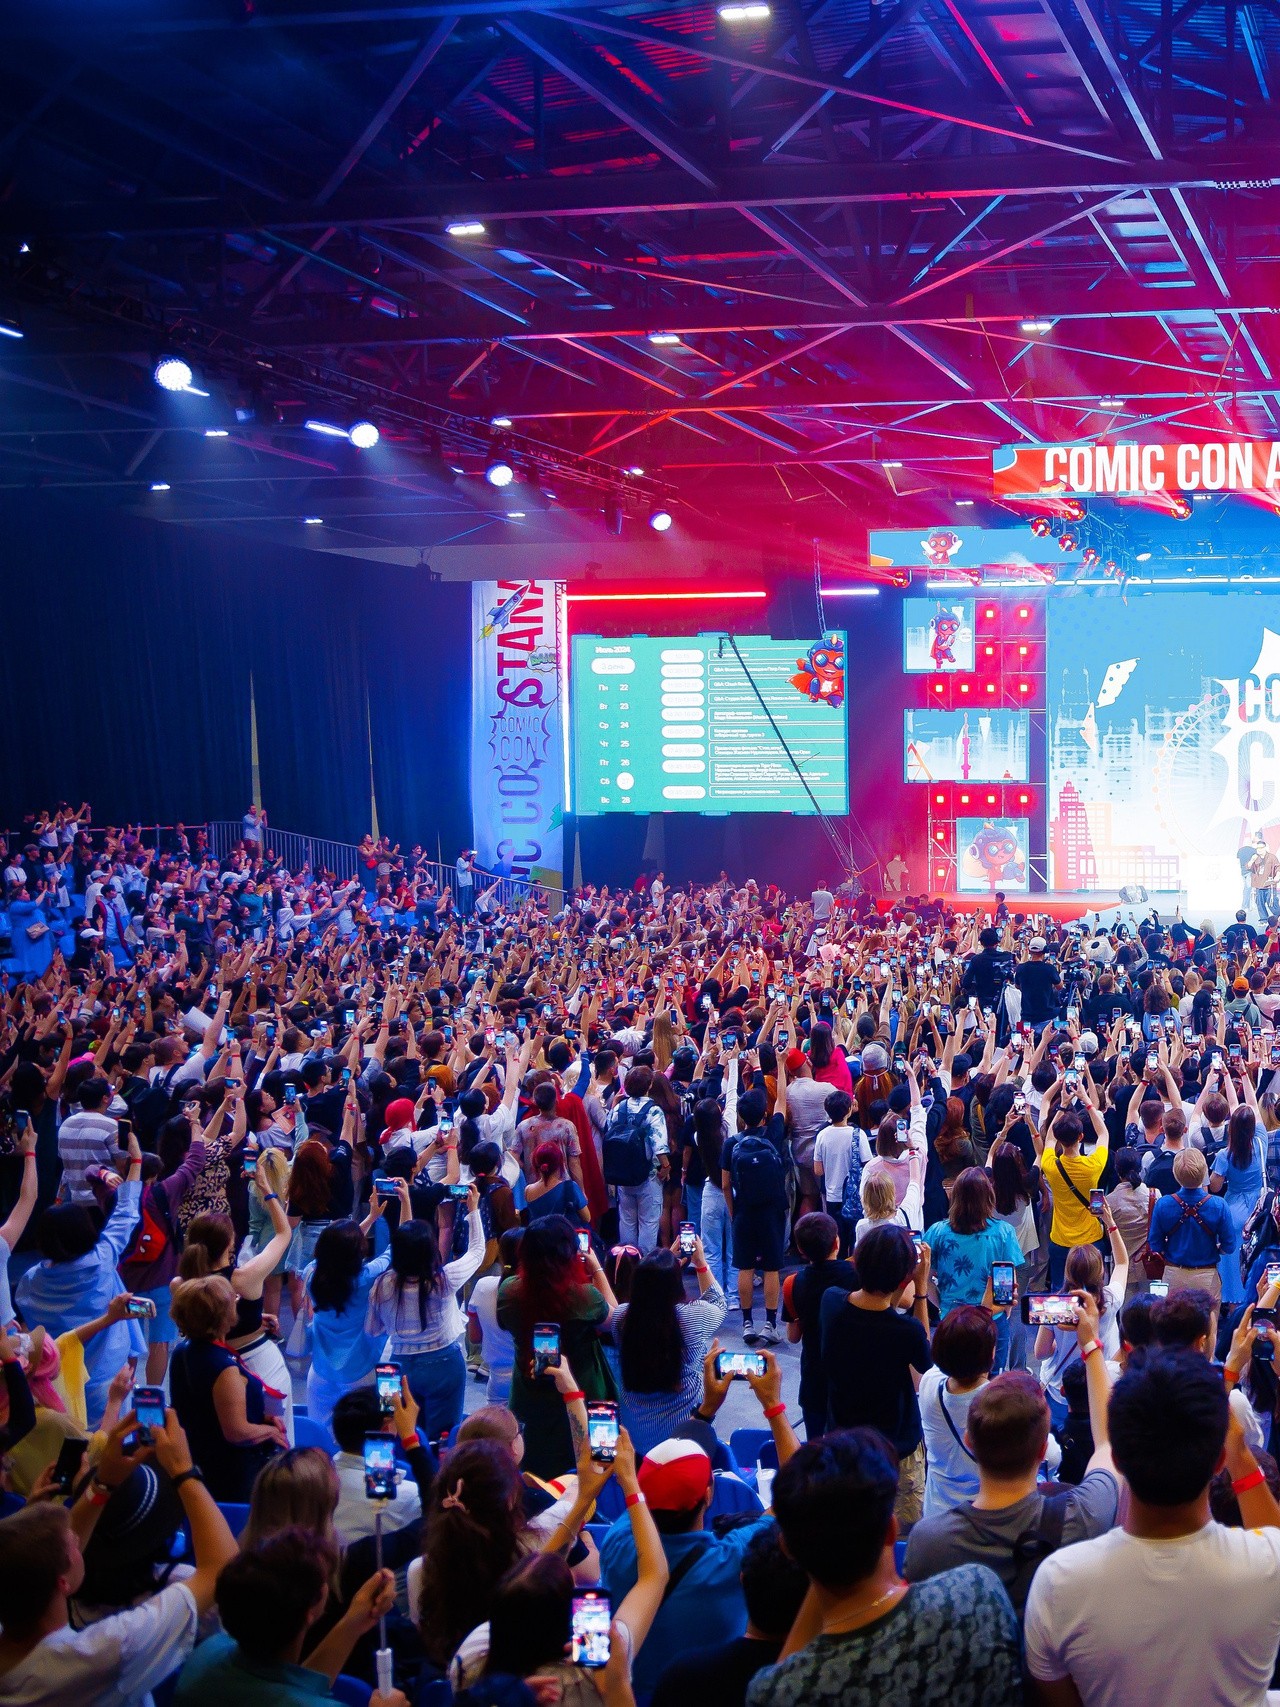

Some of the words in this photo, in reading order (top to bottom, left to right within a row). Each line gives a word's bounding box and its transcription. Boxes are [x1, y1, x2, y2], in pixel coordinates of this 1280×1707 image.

[1045, 444, 1165, 492] COMIC
[1177, 442, 1253, 490] CON
[500, 736, 538, 762] CON
